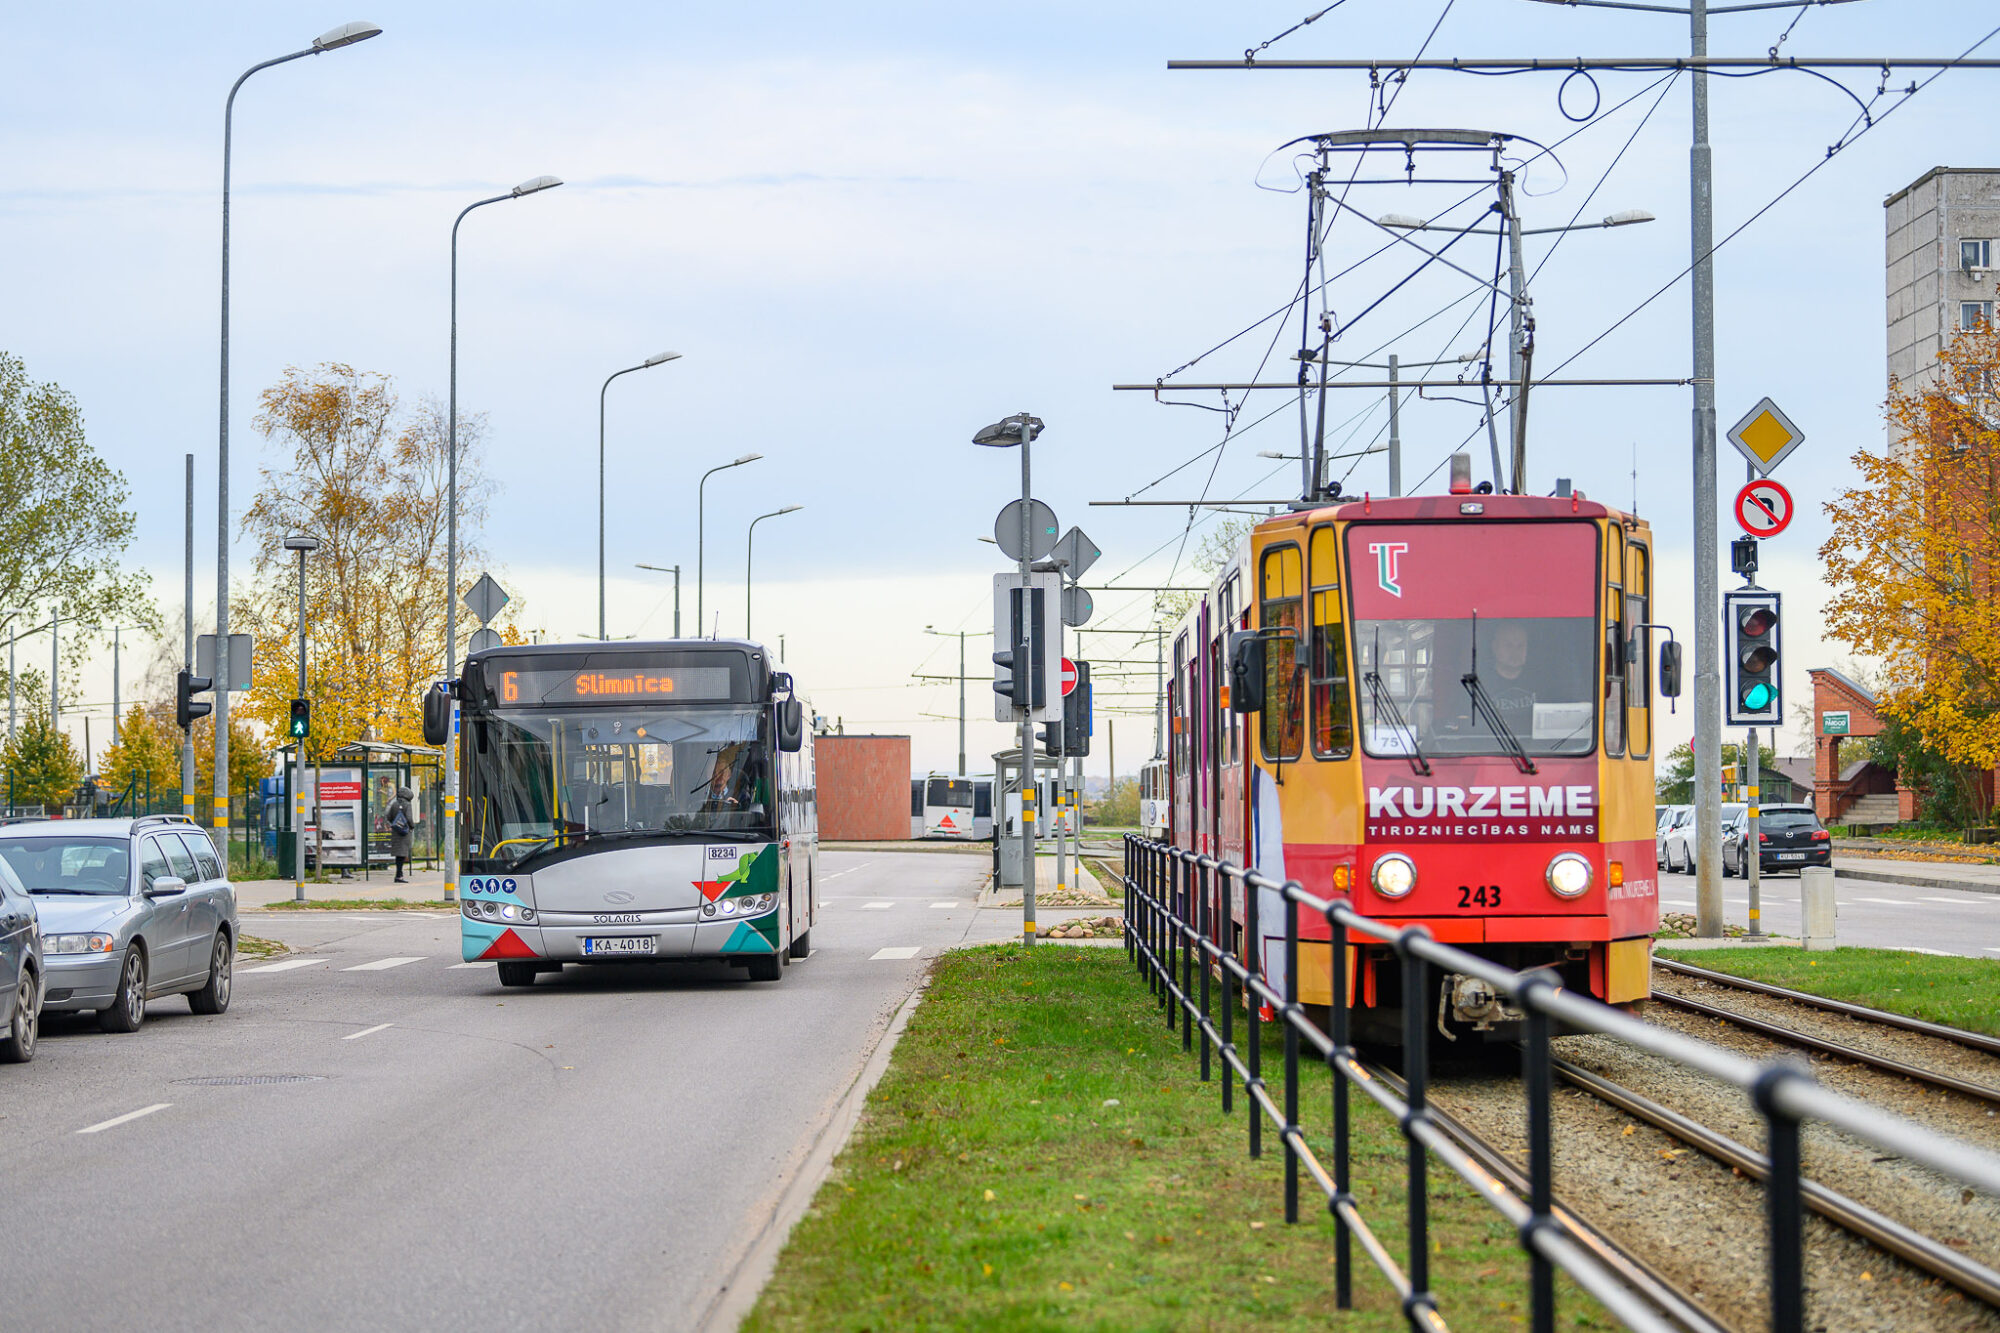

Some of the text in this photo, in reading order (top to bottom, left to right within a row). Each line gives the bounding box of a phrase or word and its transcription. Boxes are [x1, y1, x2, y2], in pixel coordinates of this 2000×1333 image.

[504, 671, 673, 701] 6 Slimnīca
[1381, 737, 1399, 747] 75
[1369, 785, 1594, 818] KURZEME
[1369, 824, 1594, 836] TIRDZNIECĪBAS NAMS
[711, 848, 734, 858] 8234
[1457, 885, 1501, 908] 243
[593, 914, 642, 924] SOLARIS
[595, 939, 650, 951] KA-4018
